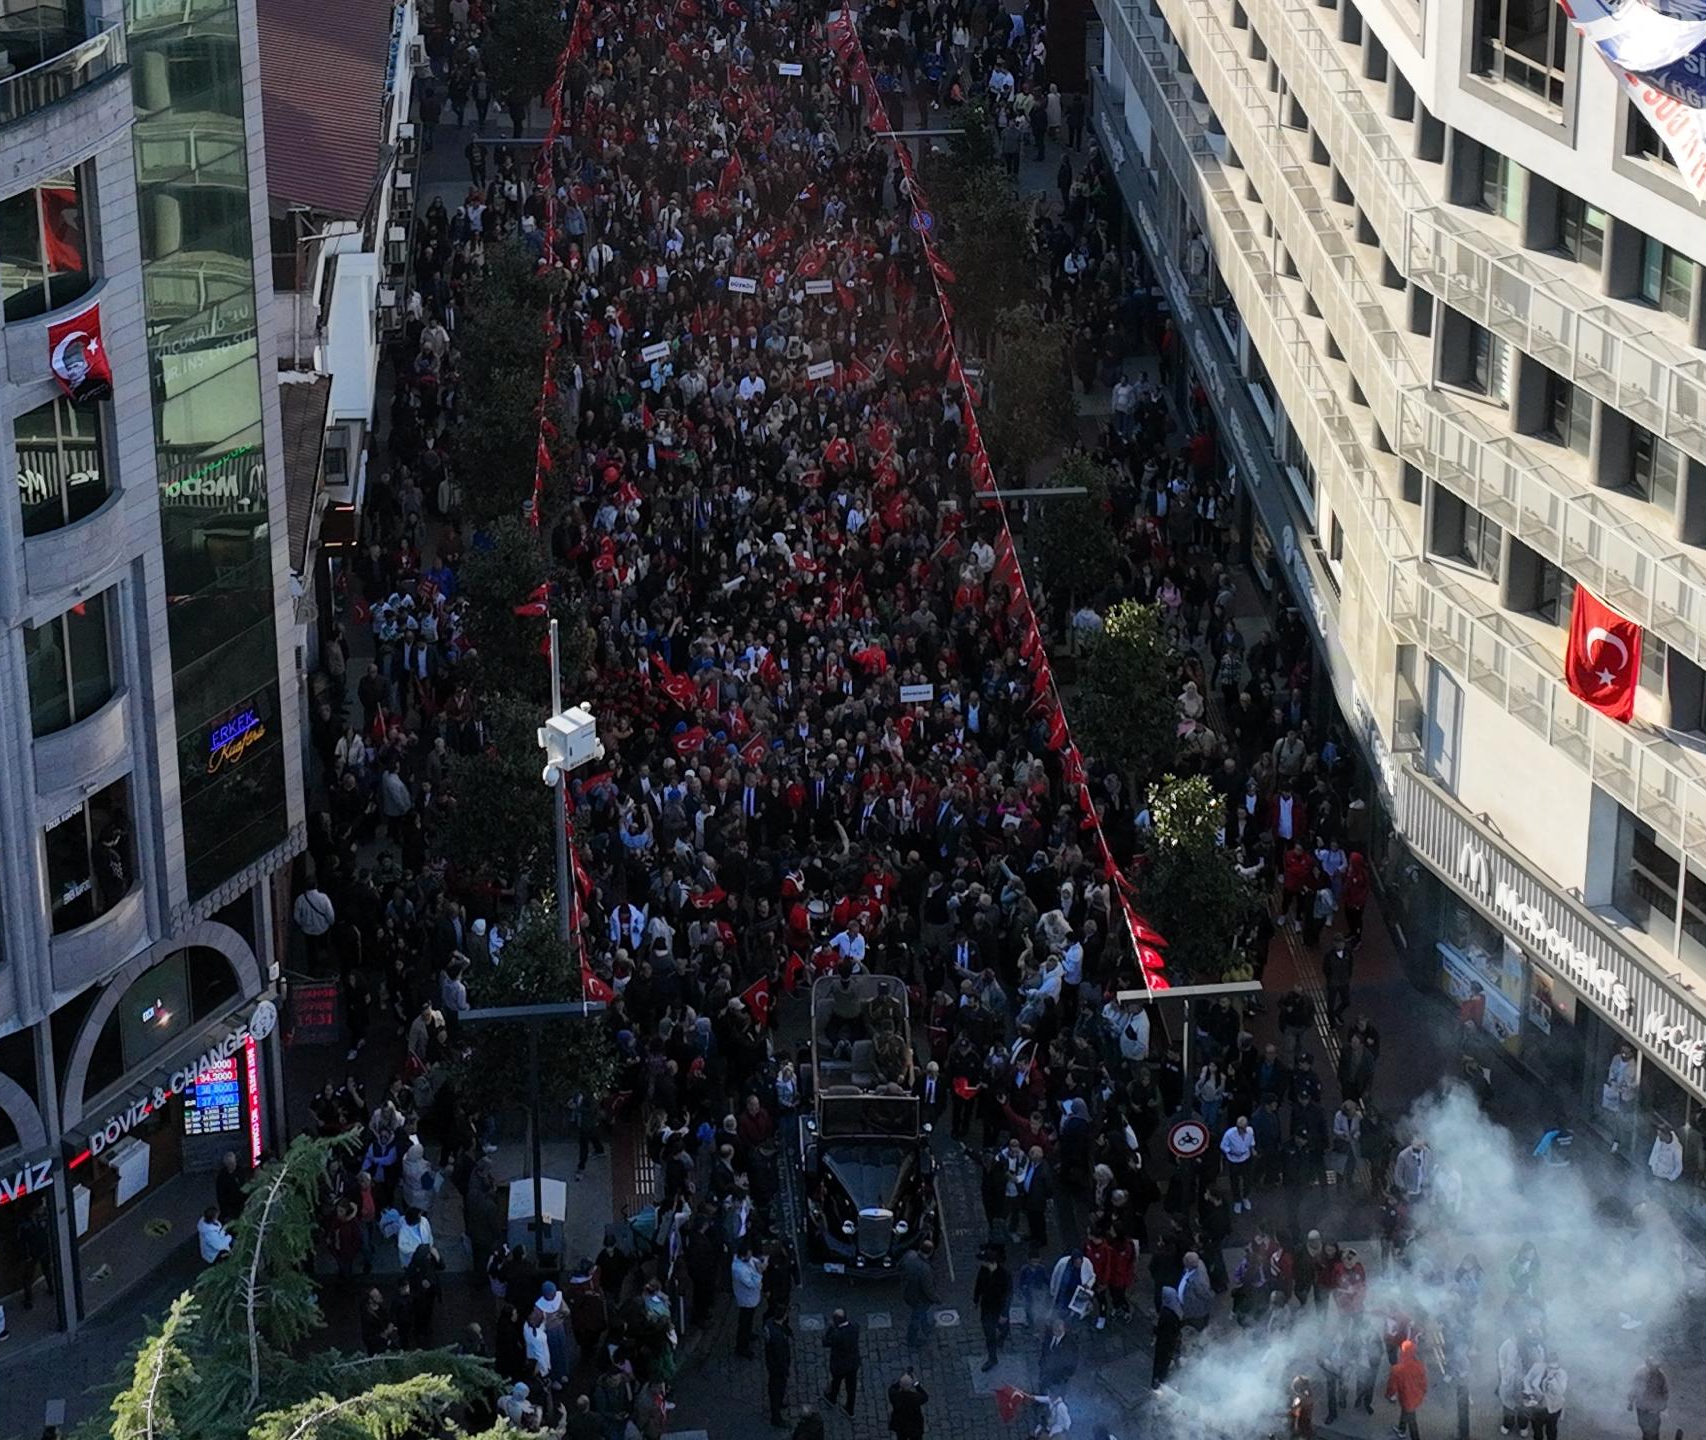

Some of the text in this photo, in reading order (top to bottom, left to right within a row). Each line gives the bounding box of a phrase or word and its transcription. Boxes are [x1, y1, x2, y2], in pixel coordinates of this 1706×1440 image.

[210, 709, 255, 745] ERKEK
[89, 1097, 150, 1157] DÖVİZ
[151, 1085, 168, 1110] &
[169, 1024, 250, 1095] CHANGE
